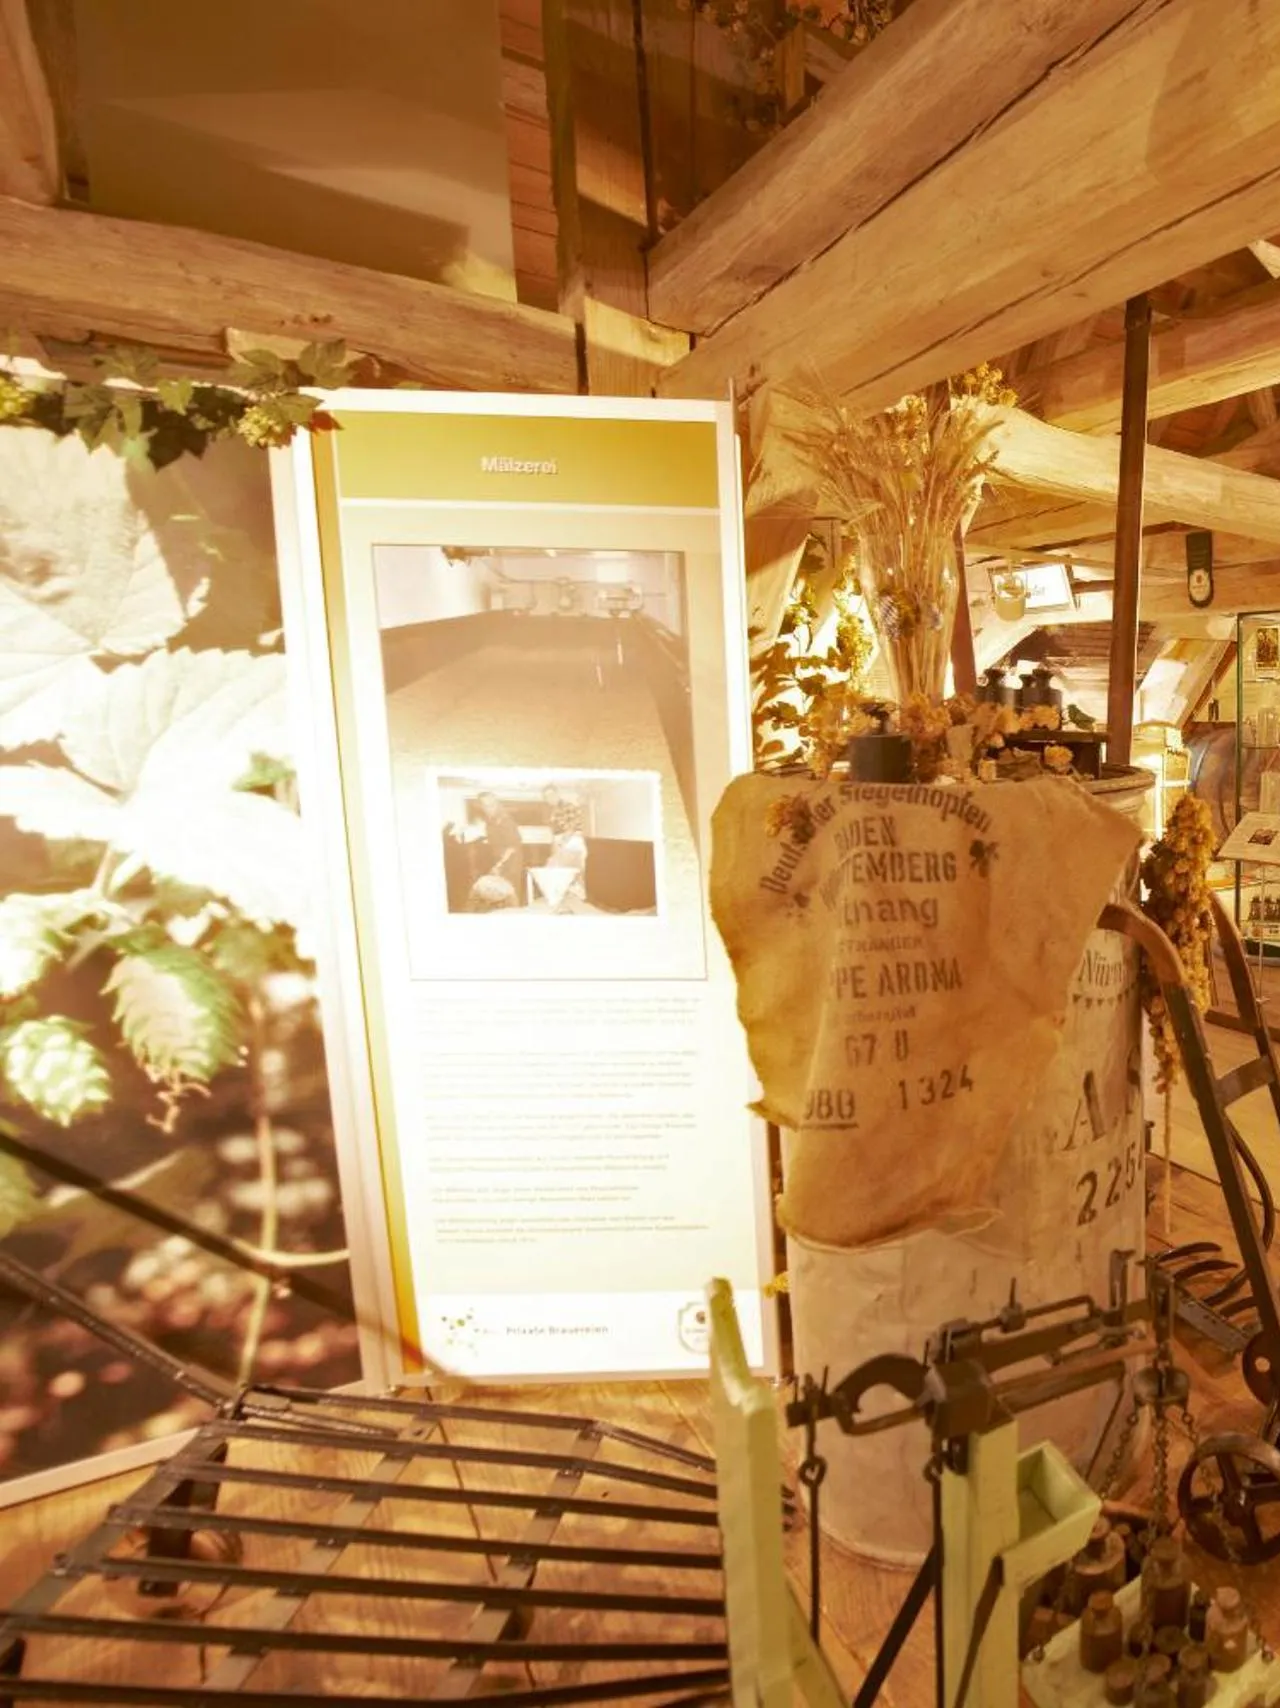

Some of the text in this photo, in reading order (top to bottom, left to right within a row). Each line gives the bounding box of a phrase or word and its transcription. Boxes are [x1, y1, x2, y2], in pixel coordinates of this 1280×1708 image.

[481, 454, 559, 475] Mälzerei
[878, 956, 963, 998] AROMA
[898, 1064, 974, 1110] 1324
